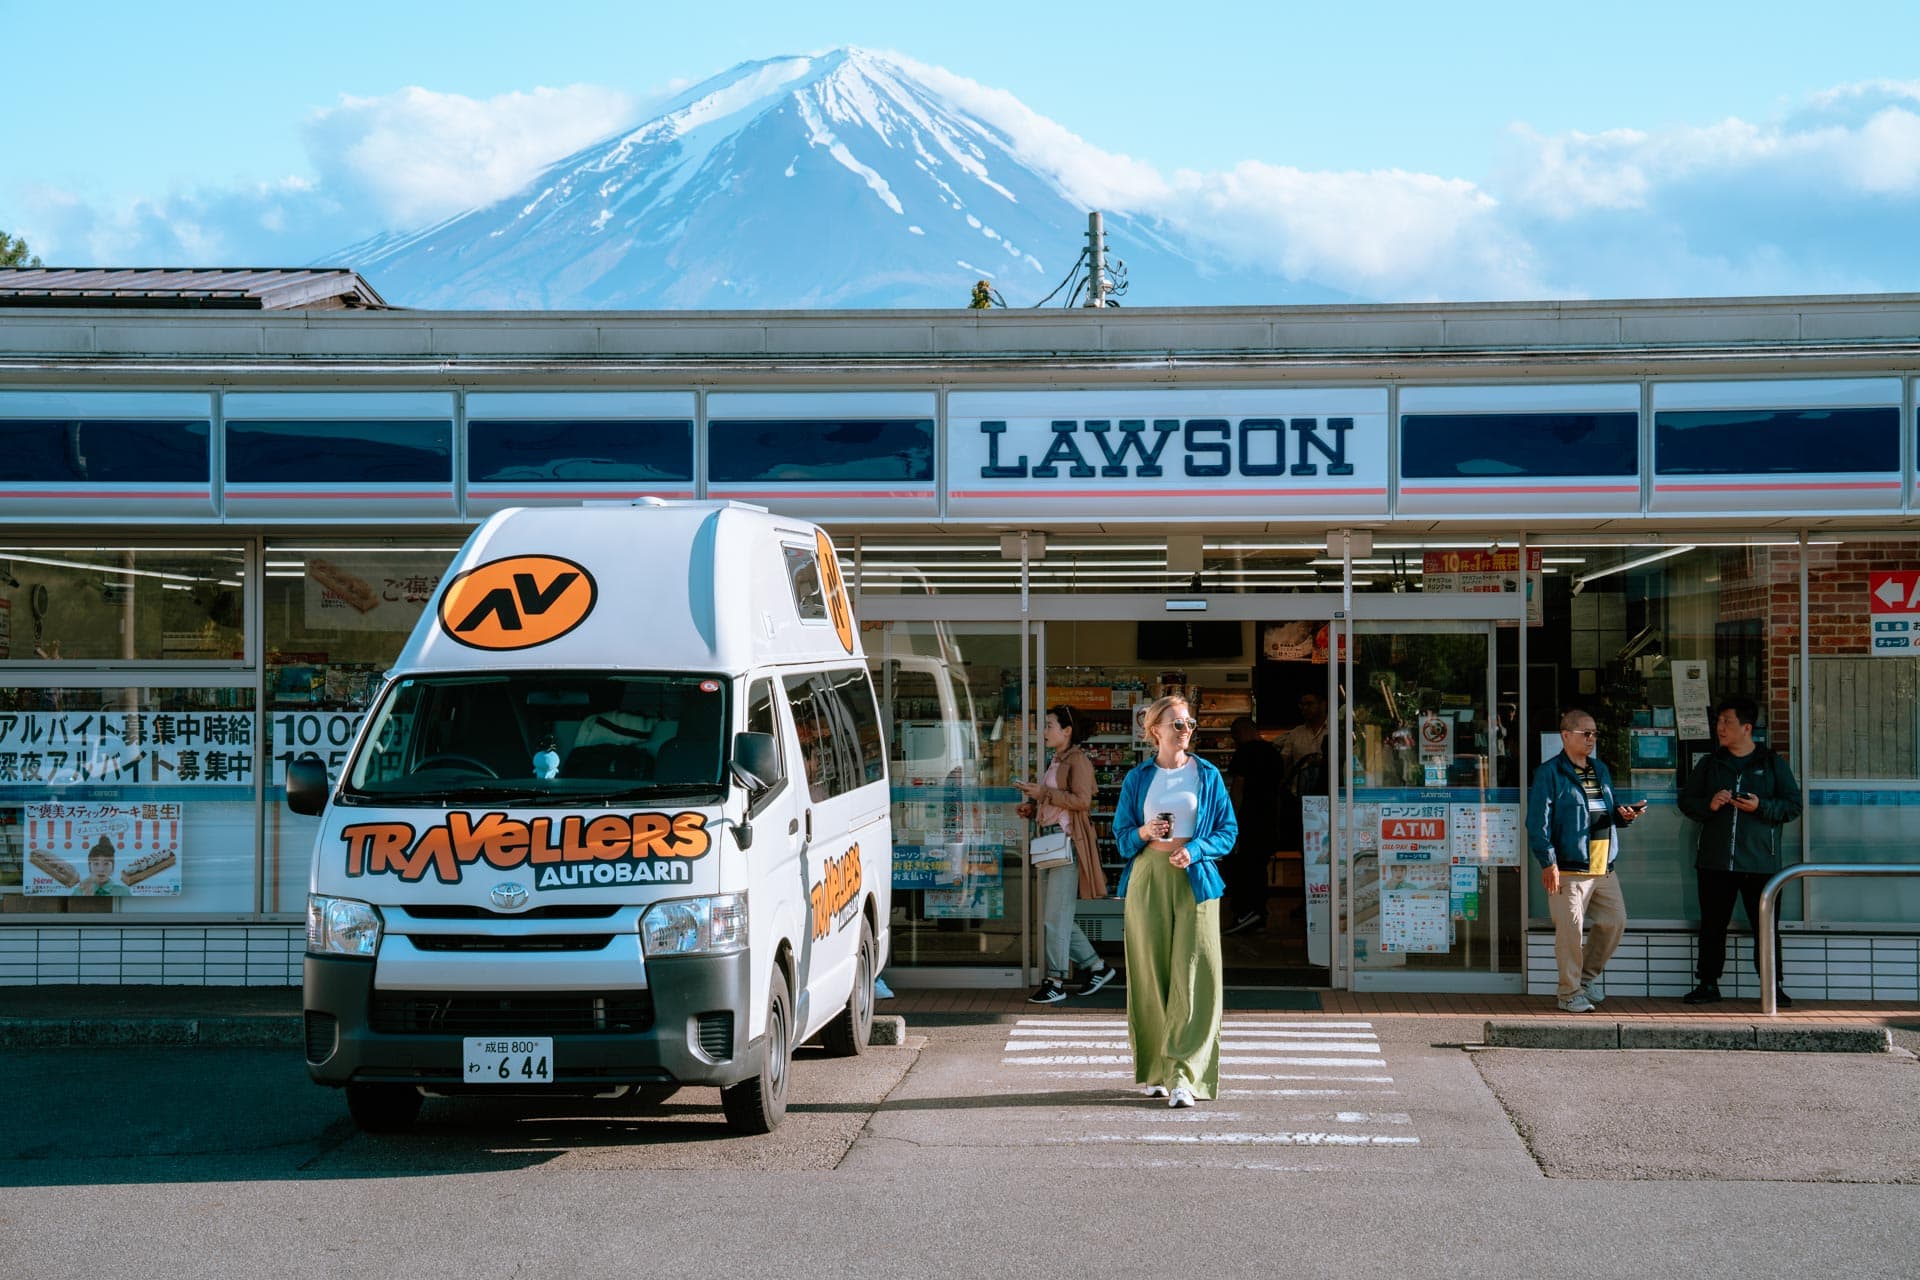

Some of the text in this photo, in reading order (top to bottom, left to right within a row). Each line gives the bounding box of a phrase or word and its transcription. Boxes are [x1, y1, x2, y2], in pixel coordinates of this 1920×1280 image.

[981, 417, 1353, 478] LAWSON
[0, 714, 252, 746] アルバイト募集中時給
[0, 750, 252, 783] 深夜アルバイト募集中
[1381, 806, 1444, 818] ローソン銀行
[1391, 822, 1435, 837] ATM
[485, 1041, 534, 1053] 成田 800
[468, 1062, 480, 1073] わ
